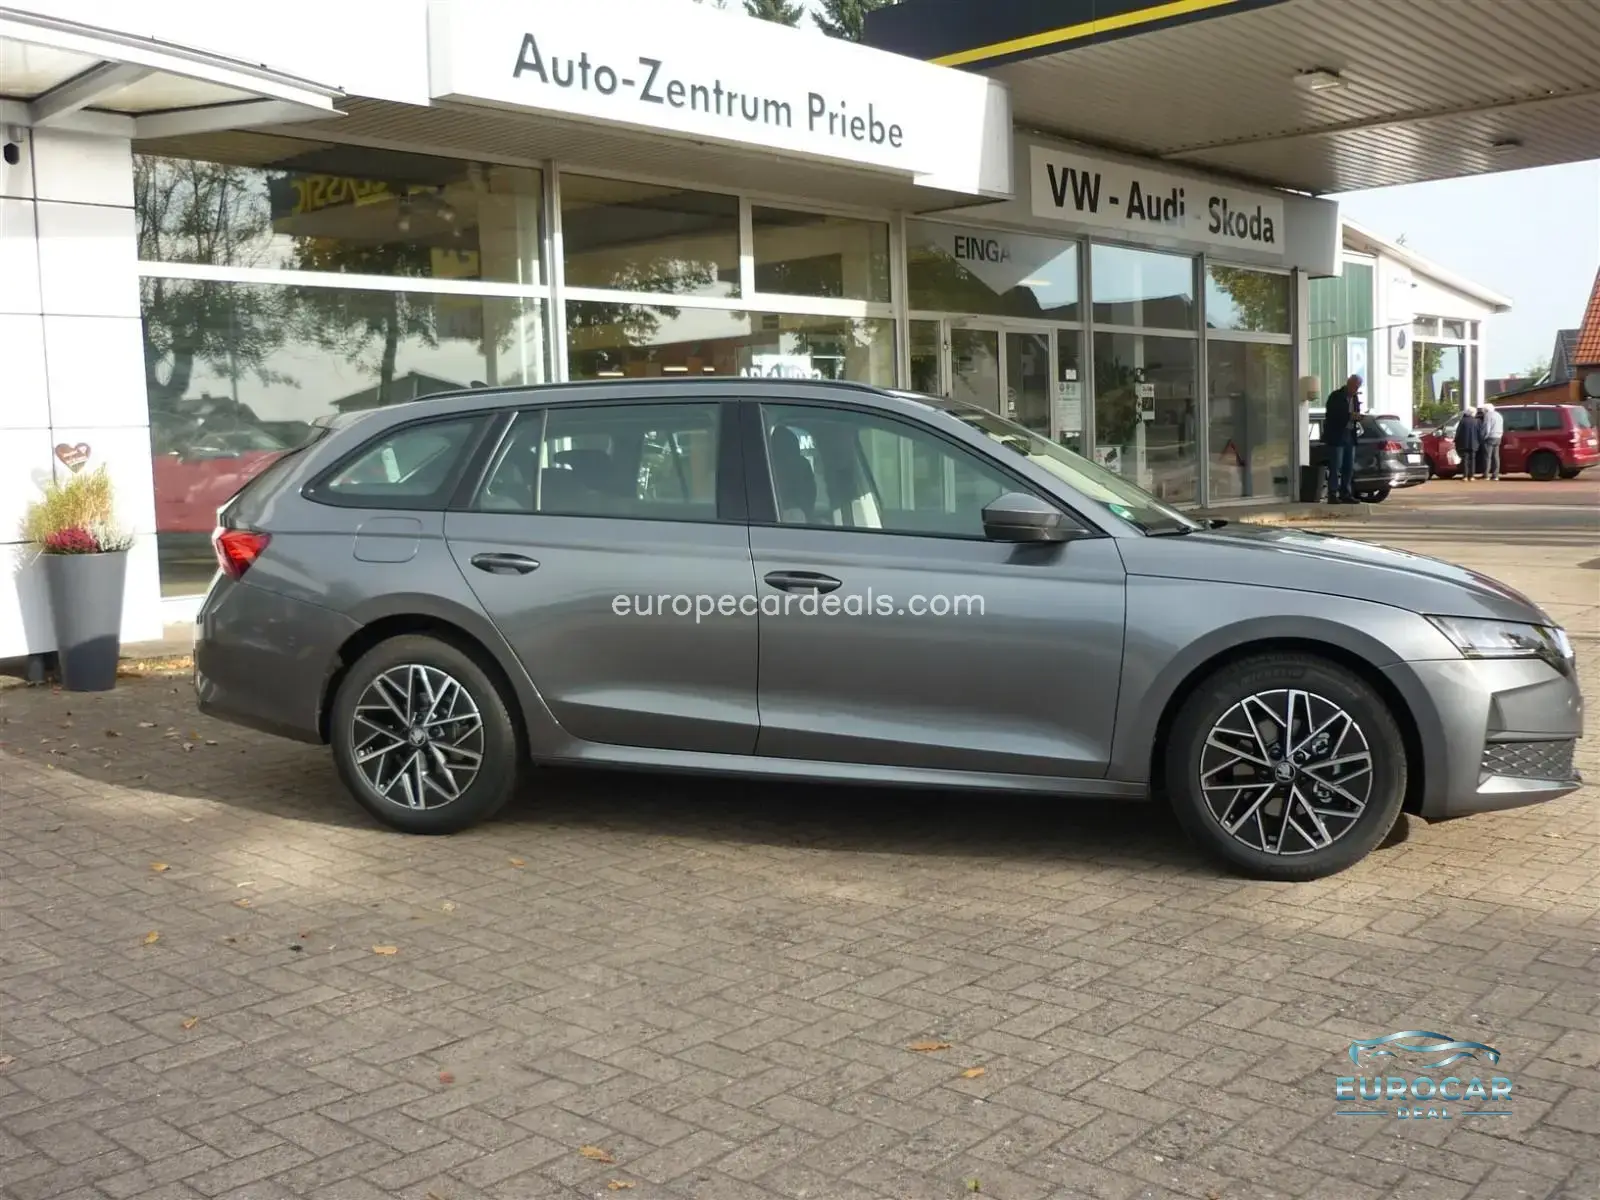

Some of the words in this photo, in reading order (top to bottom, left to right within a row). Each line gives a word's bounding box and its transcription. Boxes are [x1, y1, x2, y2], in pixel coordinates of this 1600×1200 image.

[513, 33, 791, 128] Auto-Zentrum
[808, 92, 904, 148] Priebe
[1046, 163, 1102, 213] VW
[1126, 181, 1185, 224] Audi
[1208, 196, 1275, 244] Skoda
